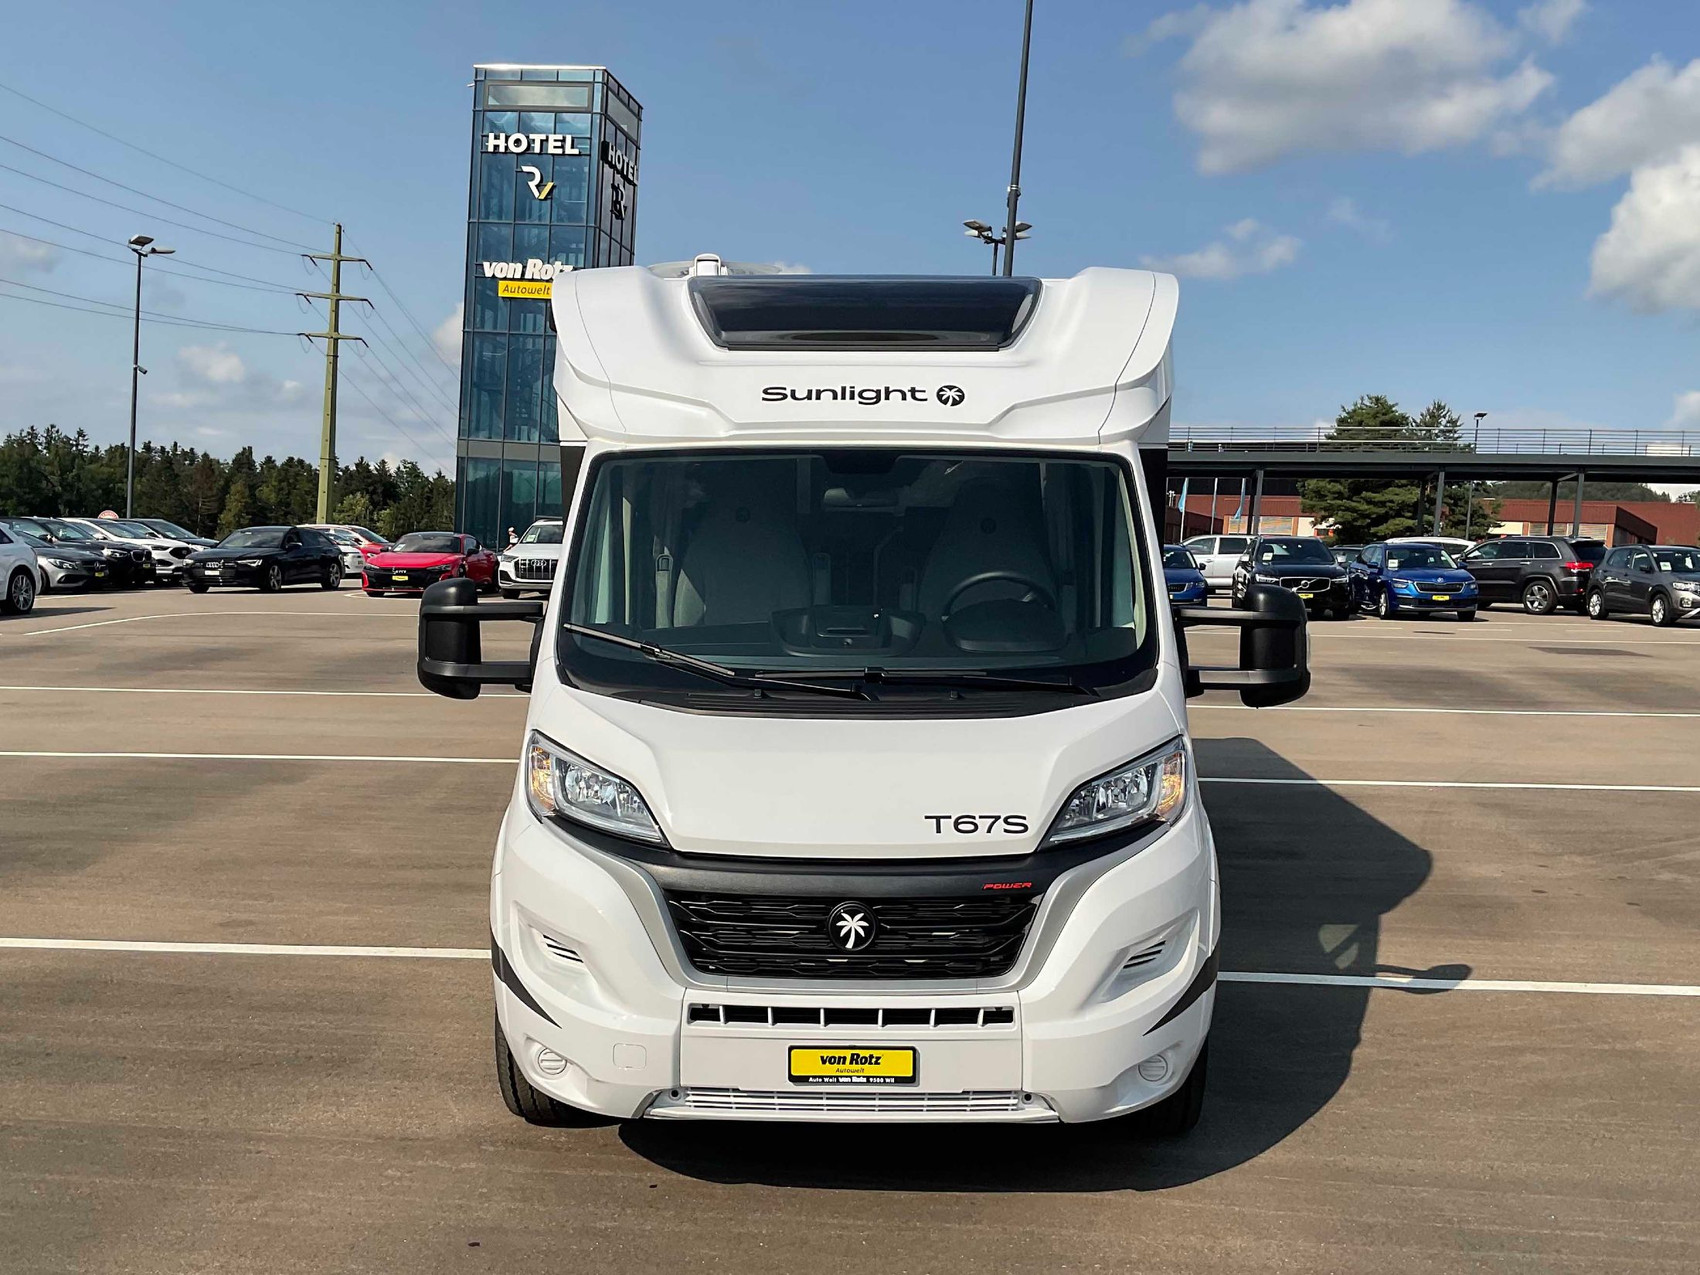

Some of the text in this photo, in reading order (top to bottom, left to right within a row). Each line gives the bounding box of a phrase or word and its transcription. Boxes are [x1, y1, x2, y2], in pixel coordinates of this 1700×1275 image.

[487, 132, 580, 155] HOTEL
[608, 141, 638, 187] HOTEL
[482, 261, 523, 279] von
[502, 285, 551, 295] Autowelt
[761, 385, 928, 406] Sunlight
[924, 815, 1029, 834] T67S
[983, 882, 1032, 890] POWER
[820, 1053, 882, 1066] von Rotz
